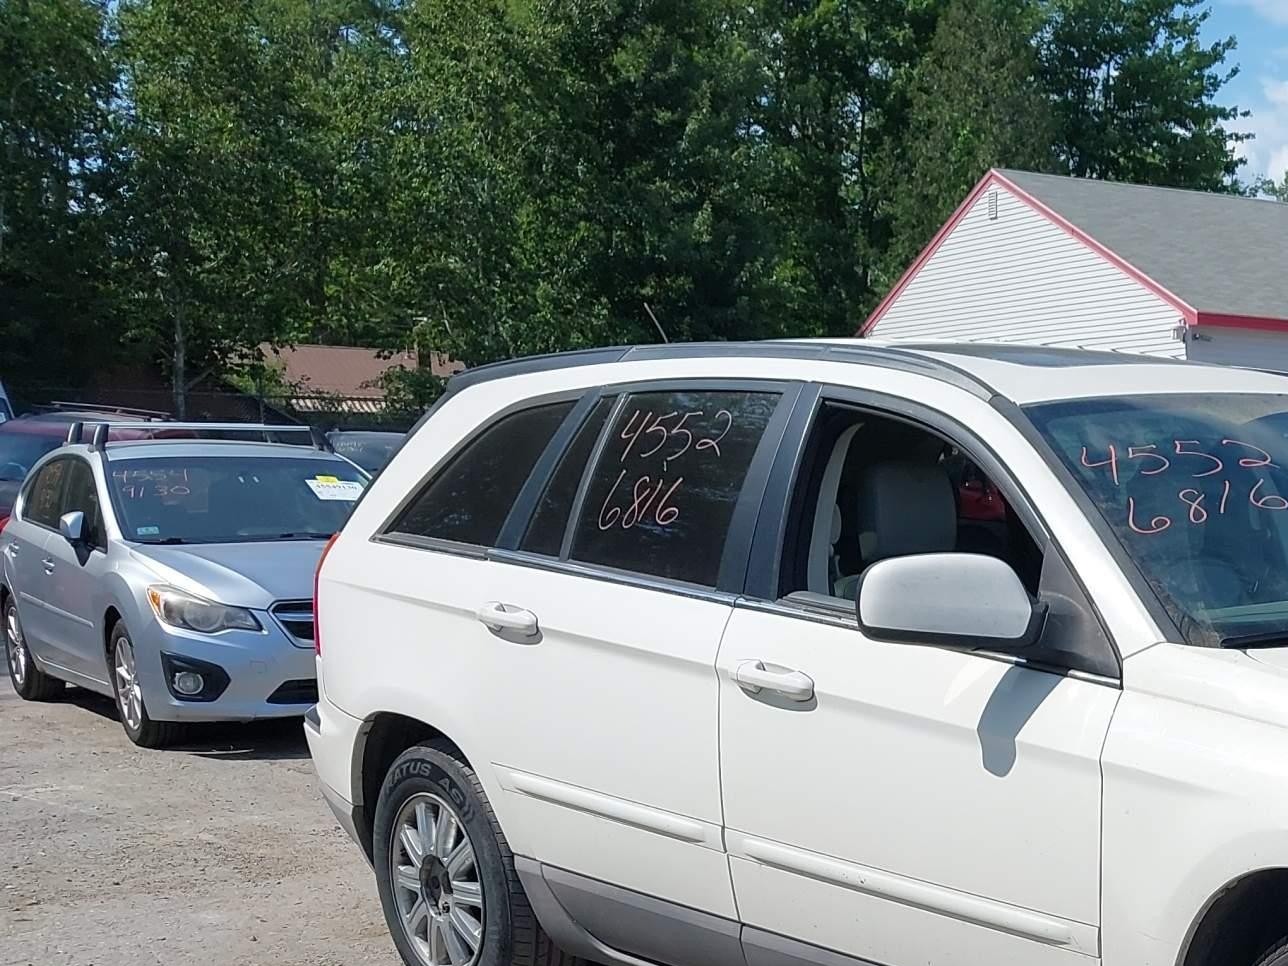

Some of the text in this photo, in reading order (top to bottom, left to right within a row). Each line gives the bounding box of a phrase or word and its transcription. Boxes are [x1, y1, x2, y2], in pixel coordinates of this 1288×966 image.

[620, 410, 732, 462] 4552
[1081, 439, 1280, 486] 4552
[598, 469, 684, 530] 6816
[1127, 478, 1288, 534] 6816
